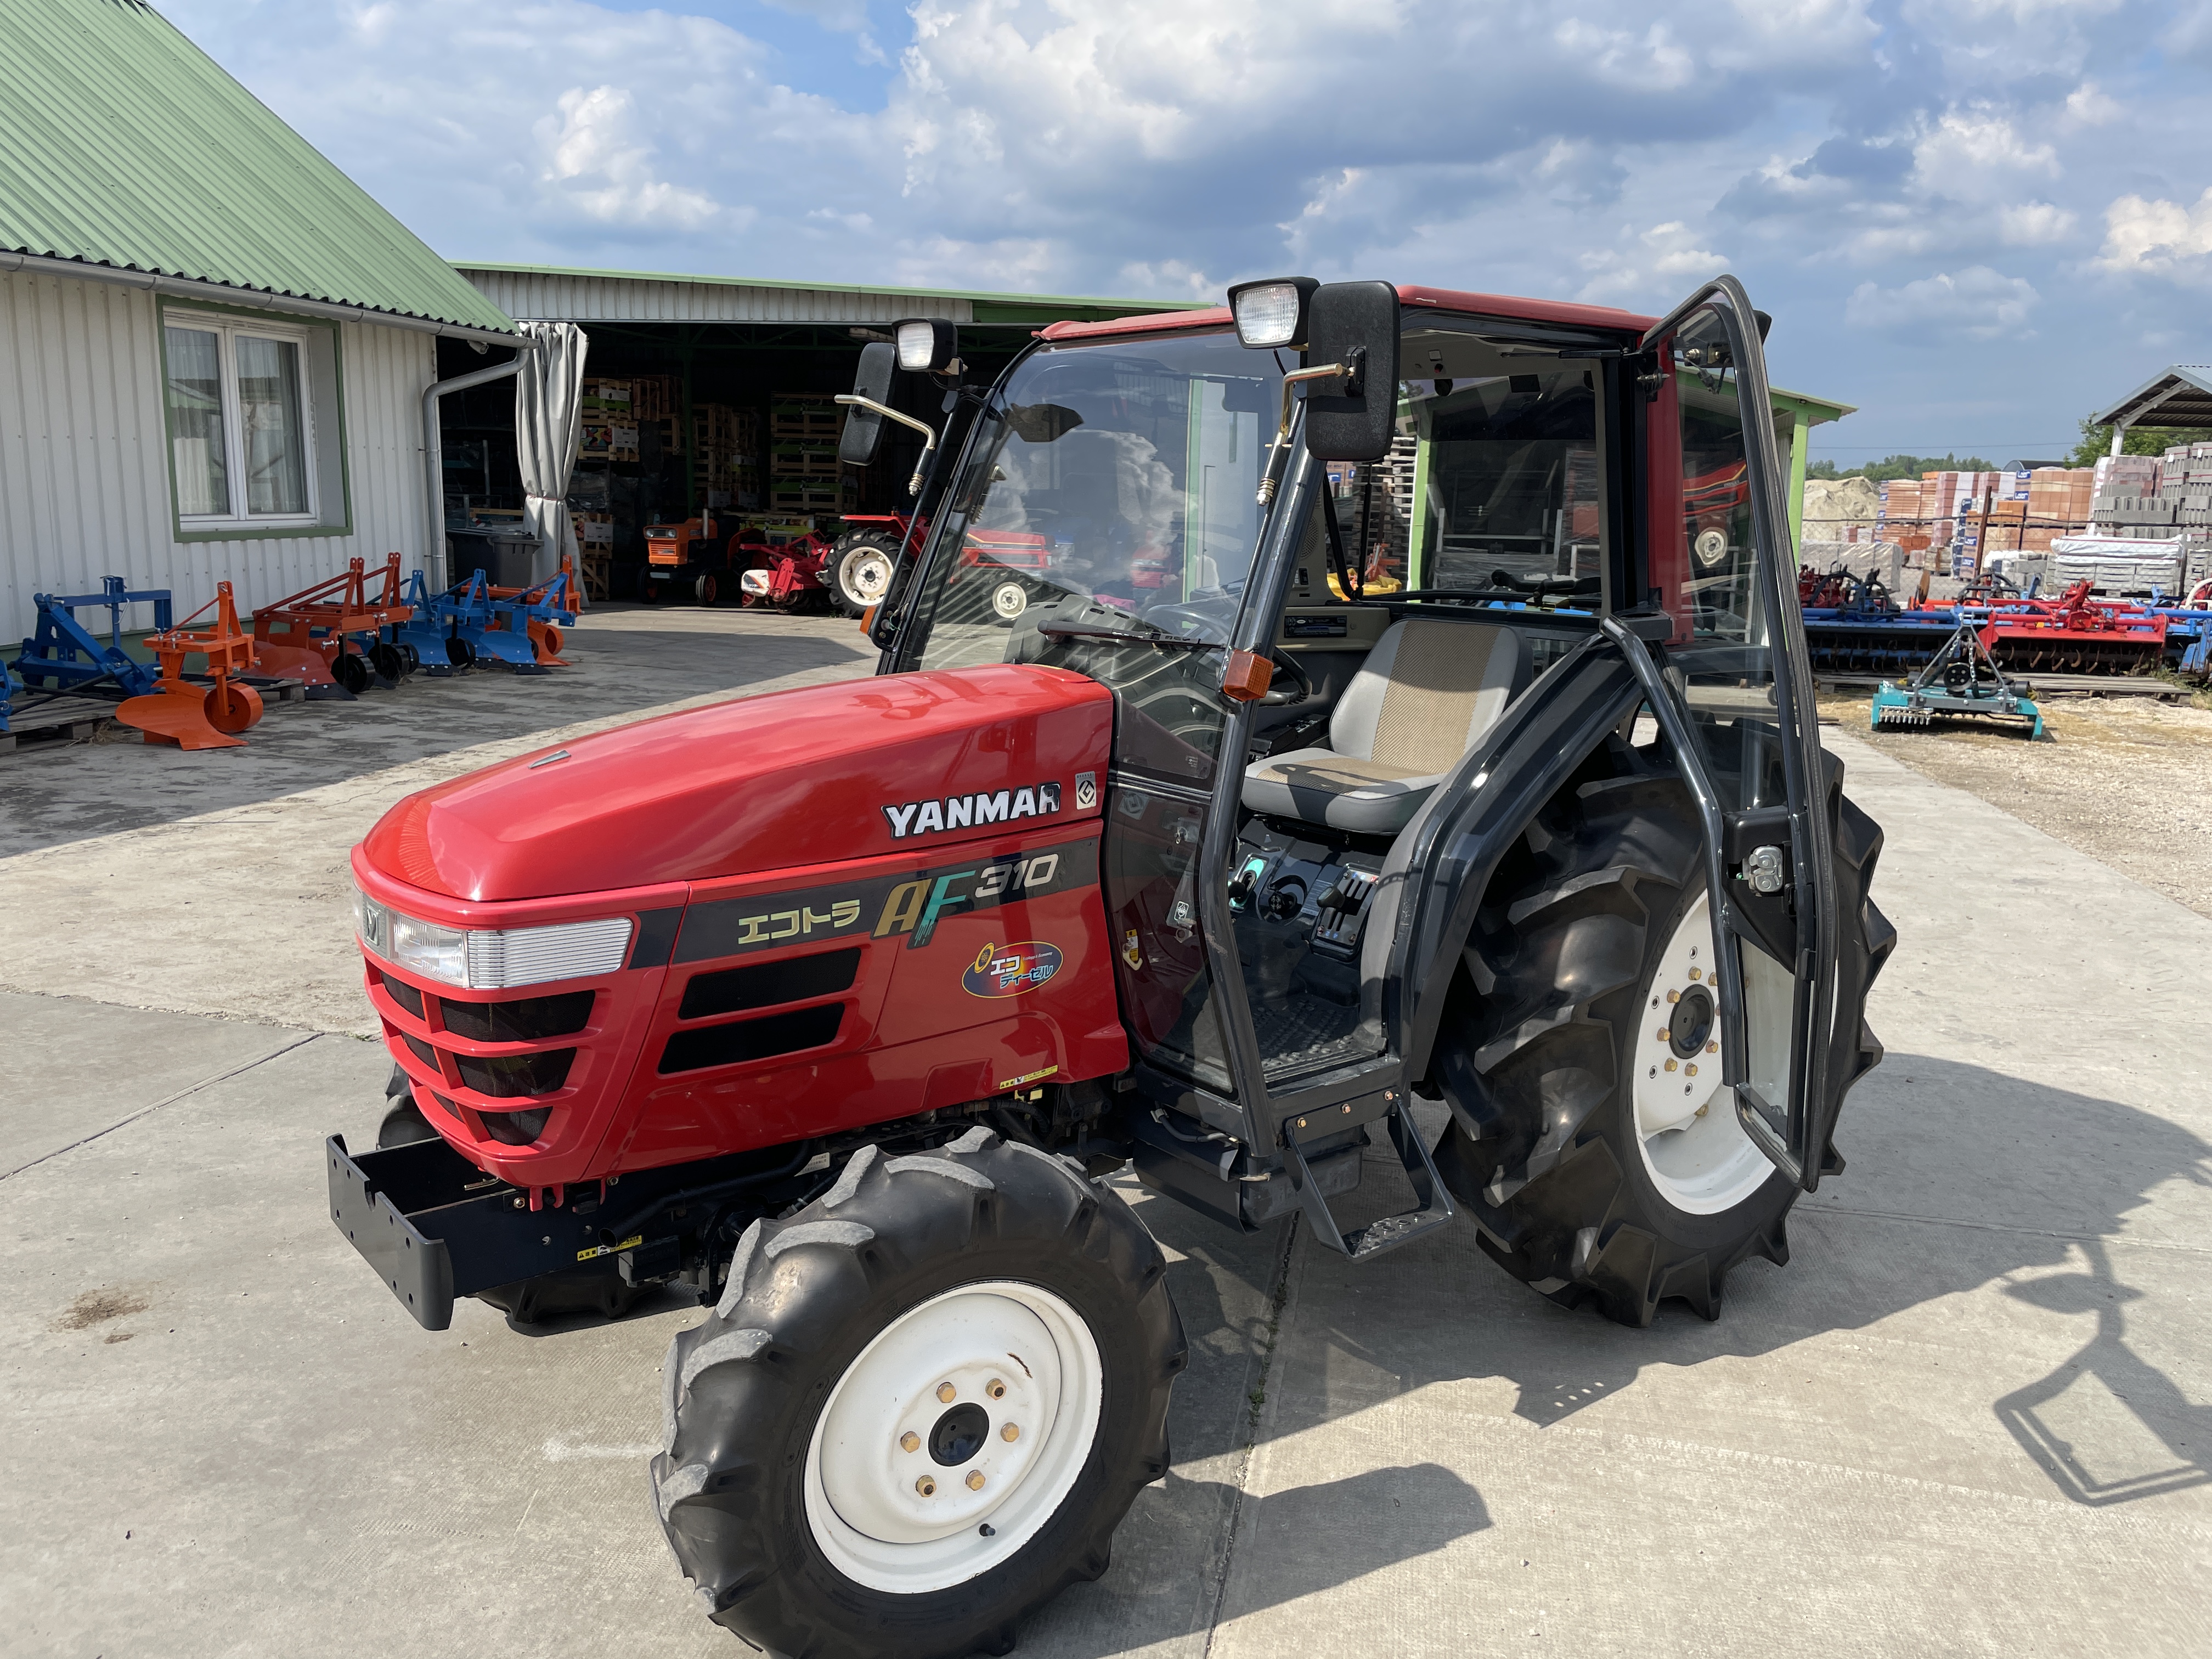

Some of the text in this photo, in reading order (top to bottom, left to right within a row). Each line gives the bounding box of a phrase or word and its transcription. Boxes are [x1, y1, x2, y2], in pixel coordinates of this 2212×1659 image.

[887, 783, 1061, 838] YANMAR
[738, 899, 861, 945] エコトラ
[991, 955, 1020, 975] エコ
[1000, 965, 1054, 989] ディーゼル
